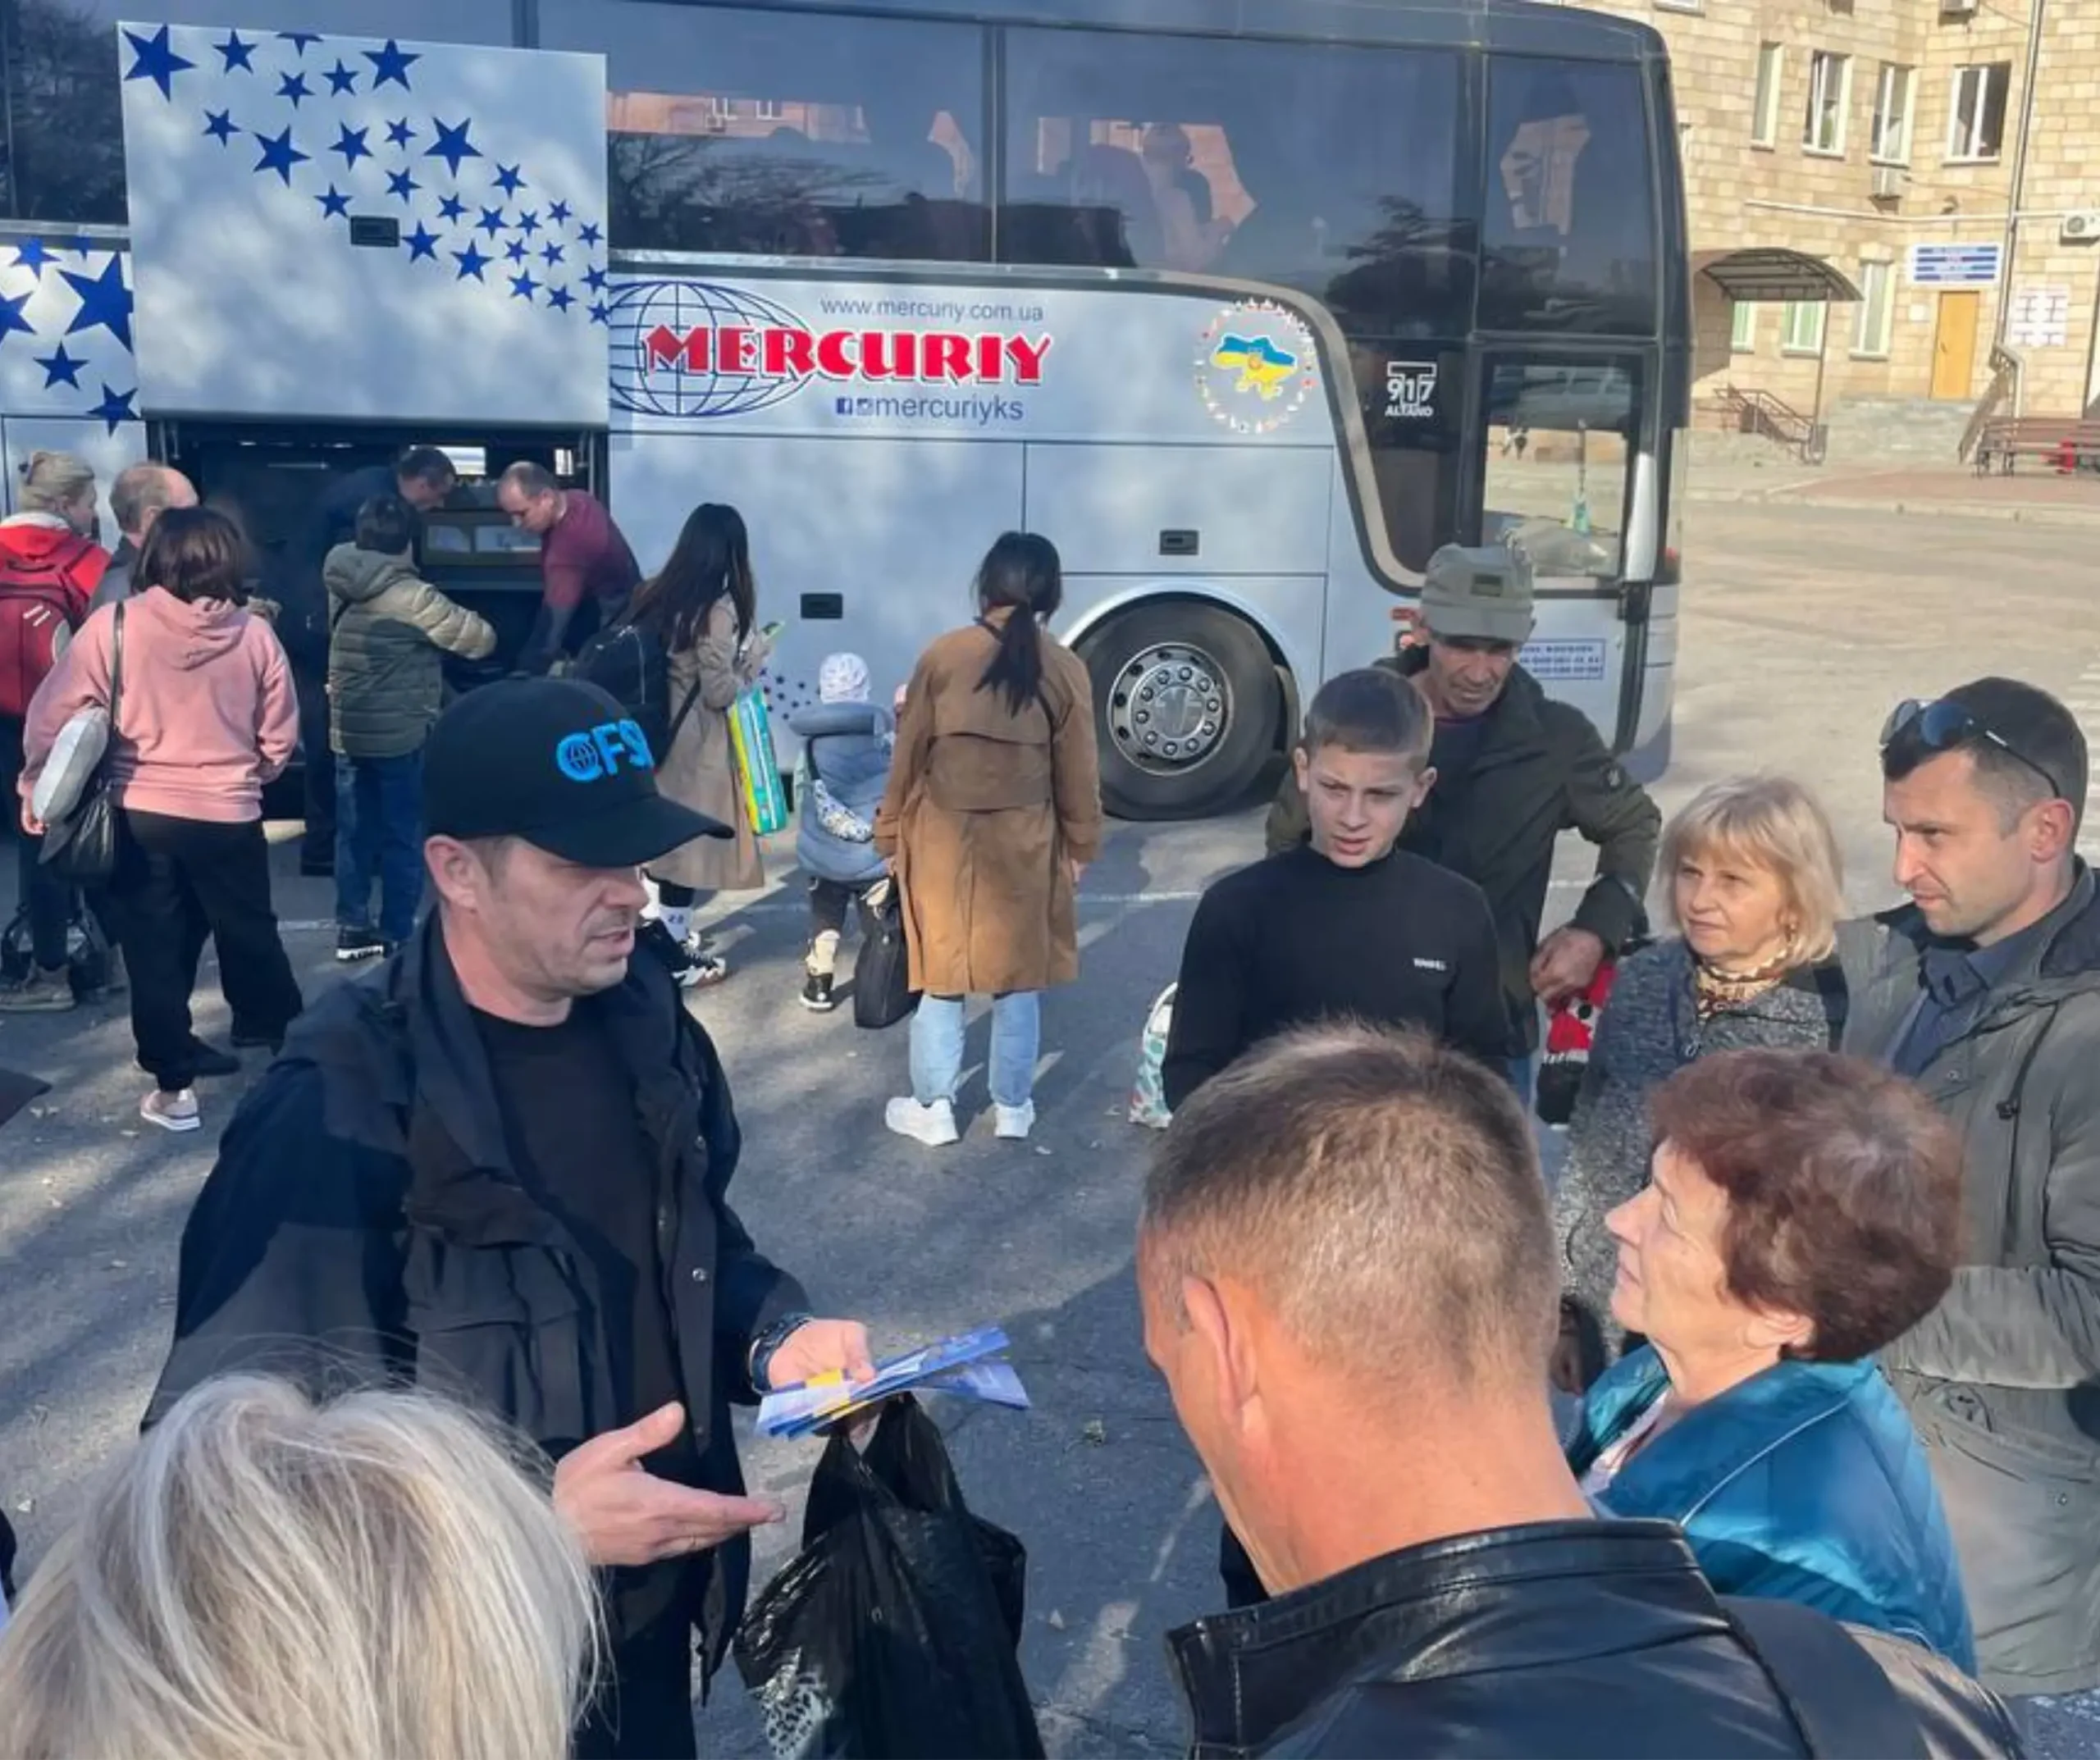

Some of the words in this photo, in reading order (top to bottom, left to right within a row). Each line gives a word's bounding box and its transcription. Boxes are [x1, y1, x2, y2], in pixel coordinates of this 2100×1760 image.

[643, 324, 1051, 385] MERCURIY
[1387, 378, 1436, 401] 917
[875, 393, 1024, 426] mercuriyks
